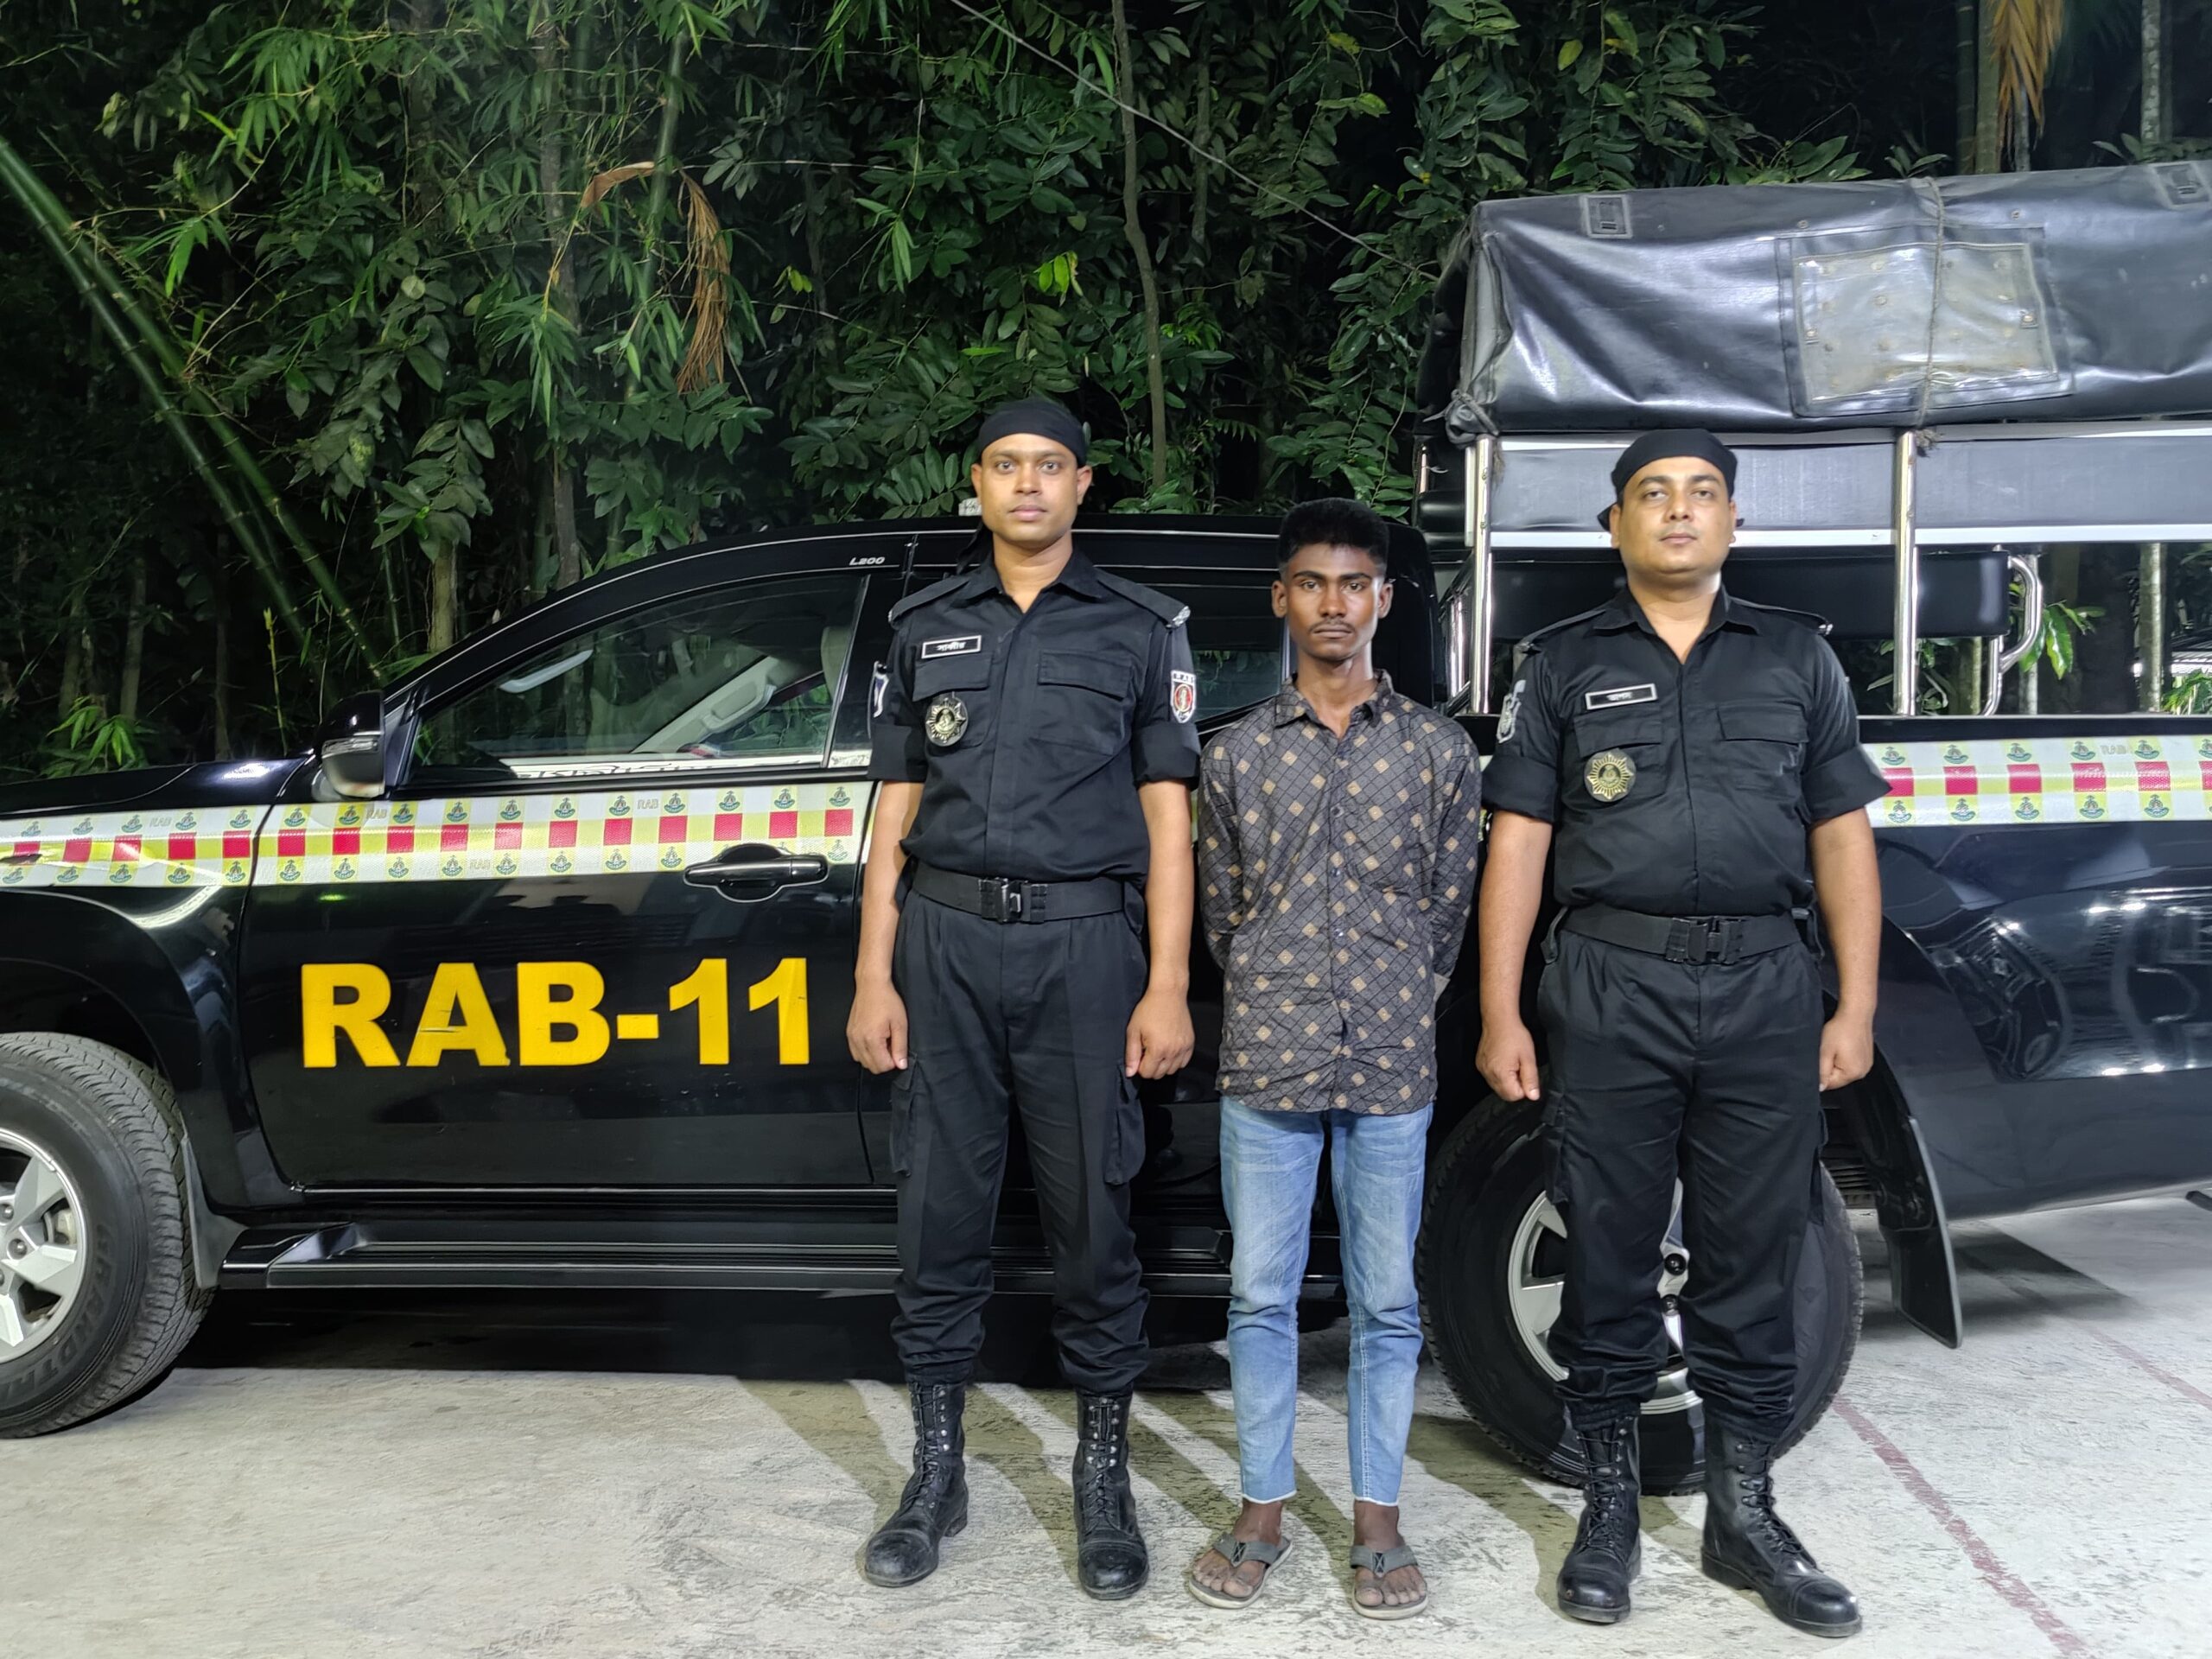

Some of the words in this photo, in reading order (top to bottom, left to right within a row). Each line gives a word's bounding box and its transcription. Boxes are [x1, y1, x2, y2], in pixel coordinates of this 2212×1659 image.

[849, 556, 885, 566] L200
[637, 798, 659, 810] RAB
[301, 957, 810, 1068] RAB-11
